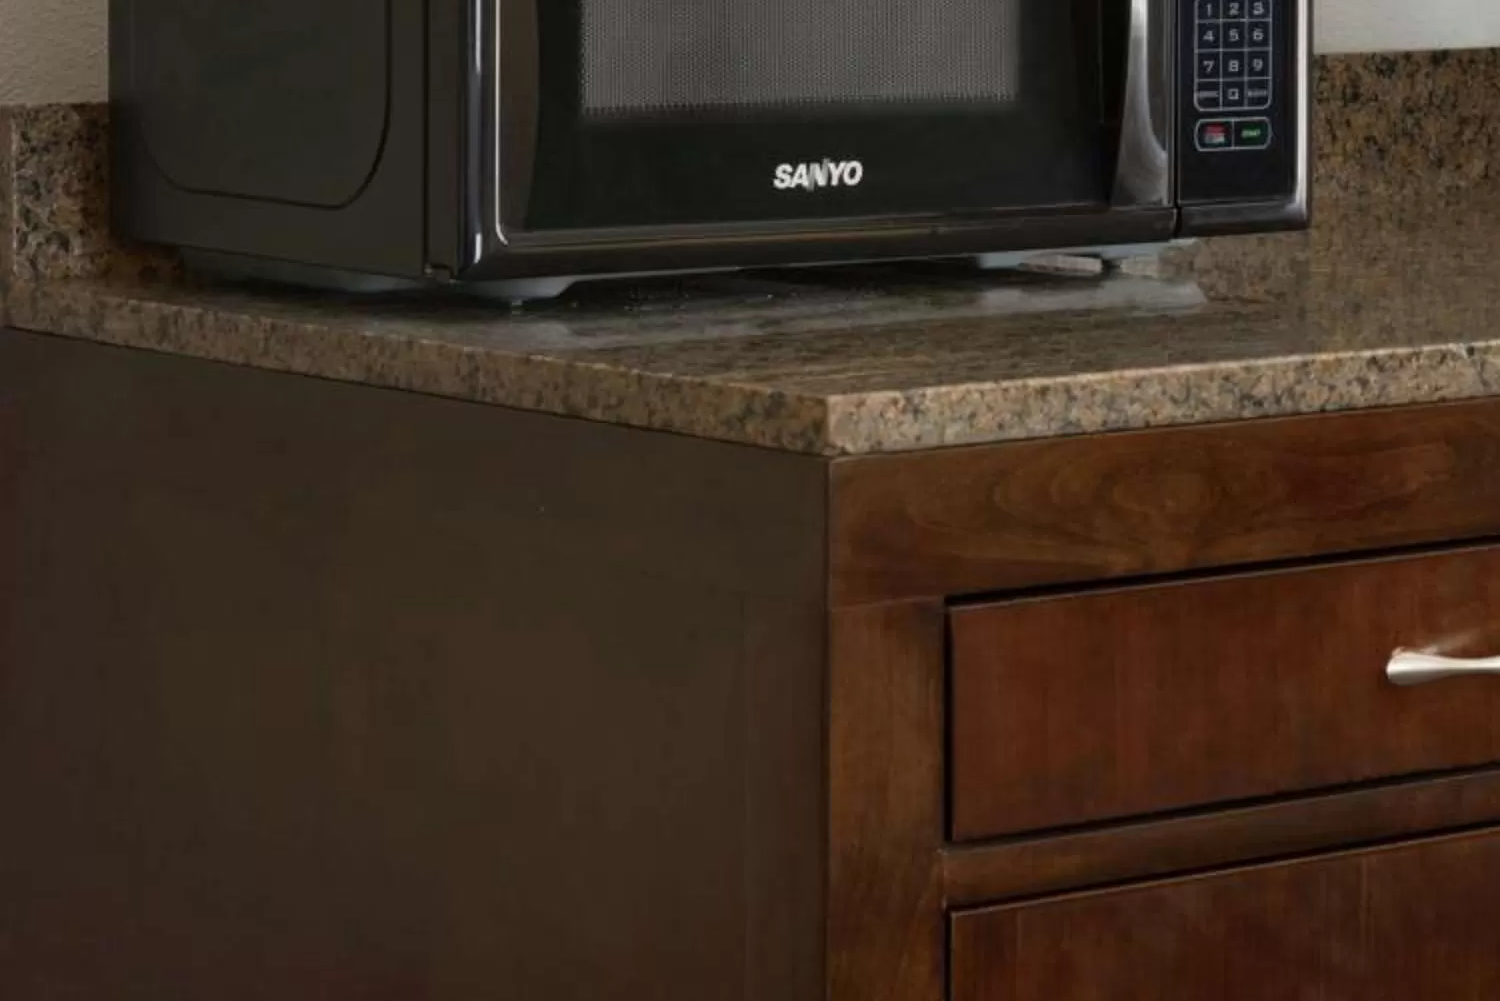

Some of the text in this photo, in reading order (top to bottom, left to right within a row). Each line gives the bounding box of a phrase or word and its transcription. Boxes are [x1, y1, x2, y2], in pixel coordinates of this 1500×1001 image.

[1206, 1, 1264, 17] 1 2 3
[1203, 28, 1264, 42] 4 5 6
[1203, 58, 1263, 74] 7 8 9
[773, 159, 863, 191] SANYO
